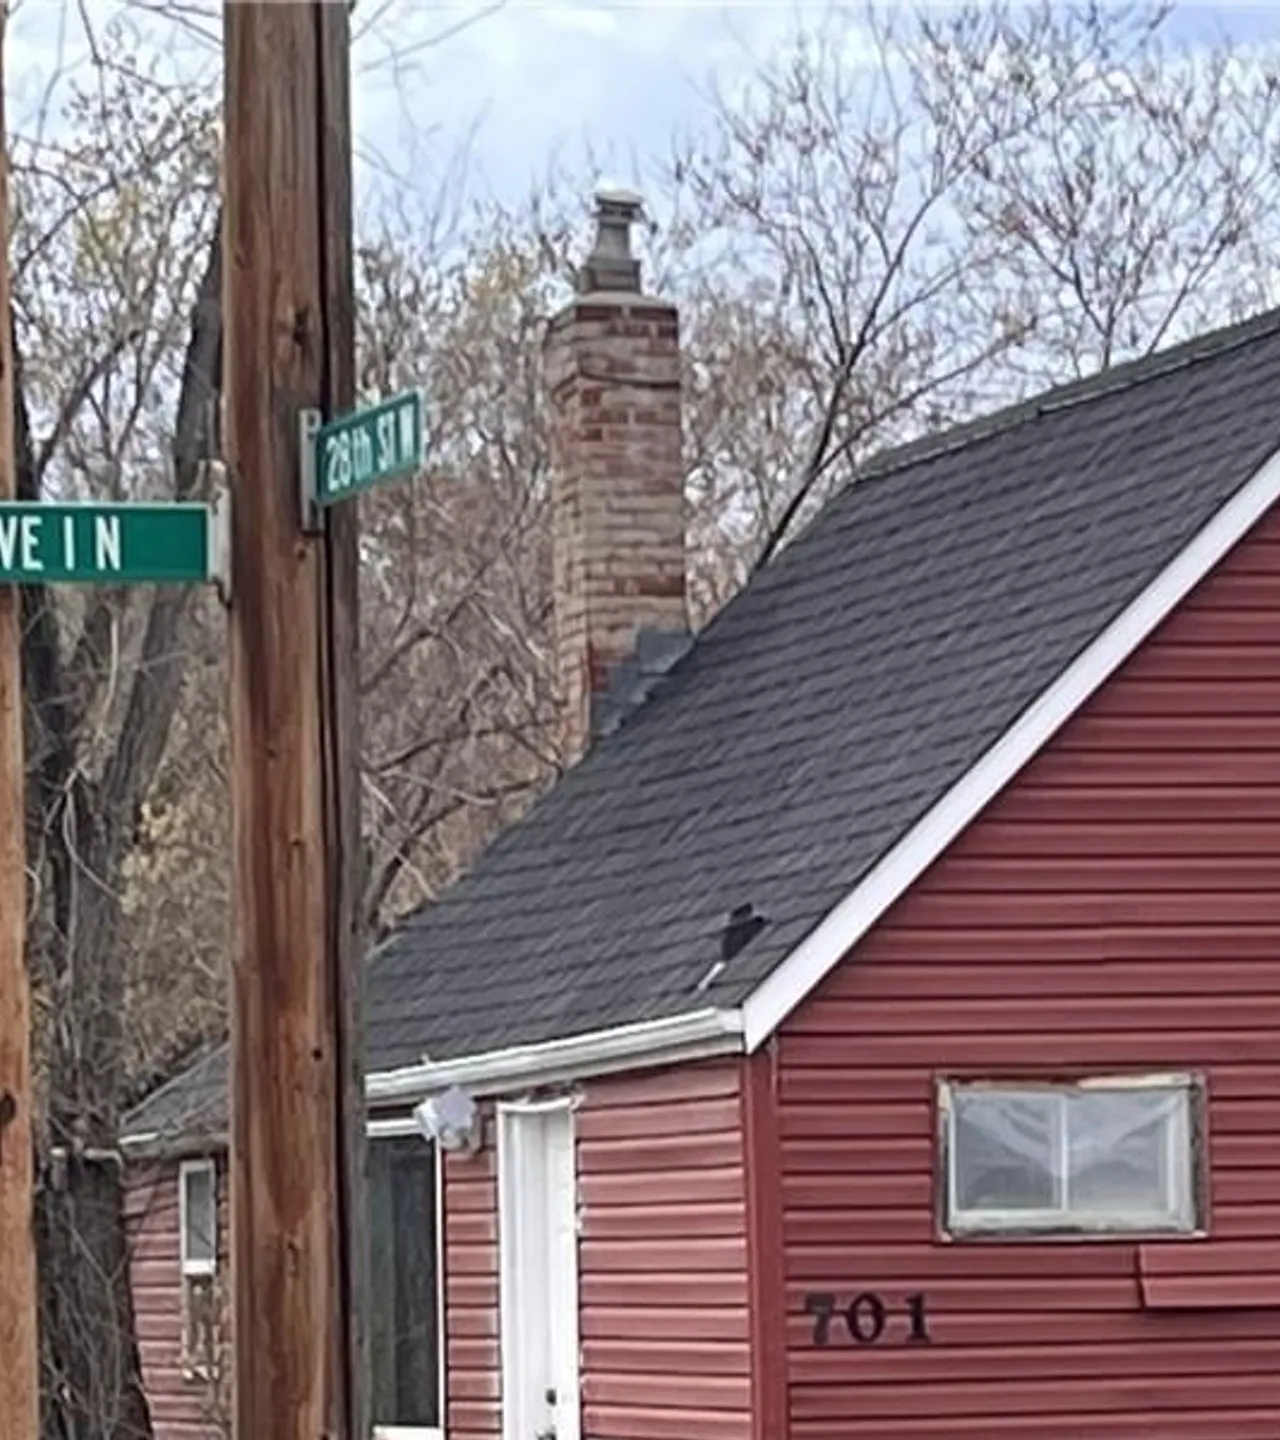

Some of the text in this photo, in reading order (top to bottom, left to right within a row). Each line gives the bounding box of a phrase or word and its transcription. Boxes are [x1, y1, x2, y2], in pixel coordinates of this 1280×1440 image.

[63, 515, 75, 571] I
[95, 514, 120, 571] N
[804, 1290, 932, 1346] 701
